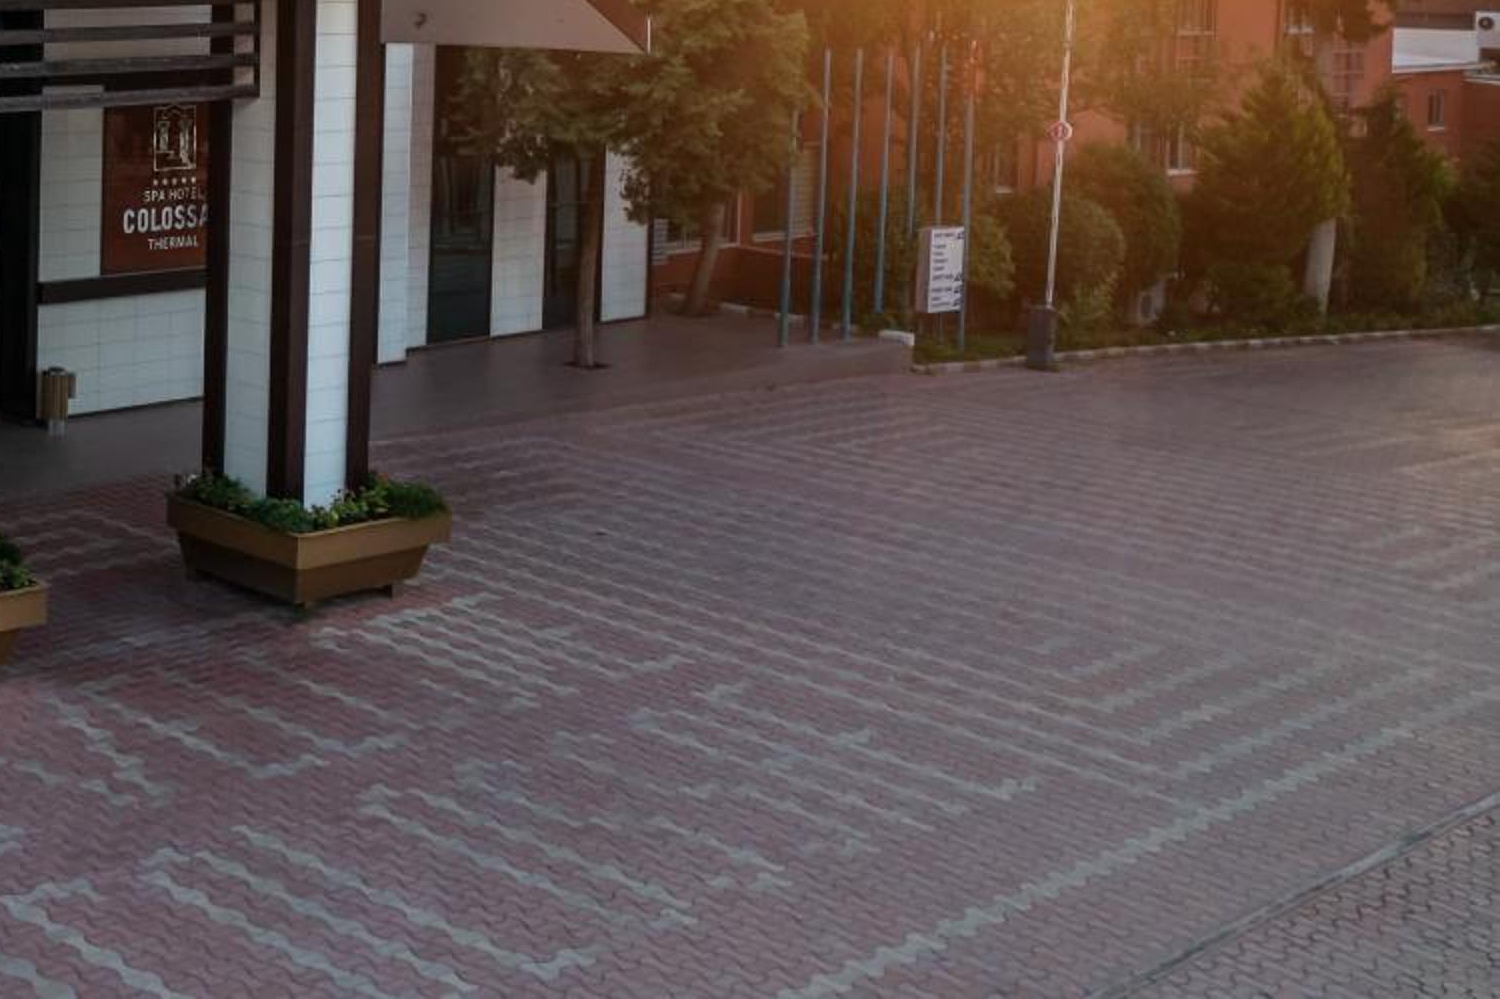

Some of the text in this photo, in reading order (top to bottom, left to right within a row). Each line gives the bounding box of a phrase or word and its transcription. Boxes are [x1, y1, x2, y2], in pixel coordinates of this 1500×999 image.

[143, 186, 206, 202] SPA HOTEL
[148, 235, 198, 250] THERMAL
